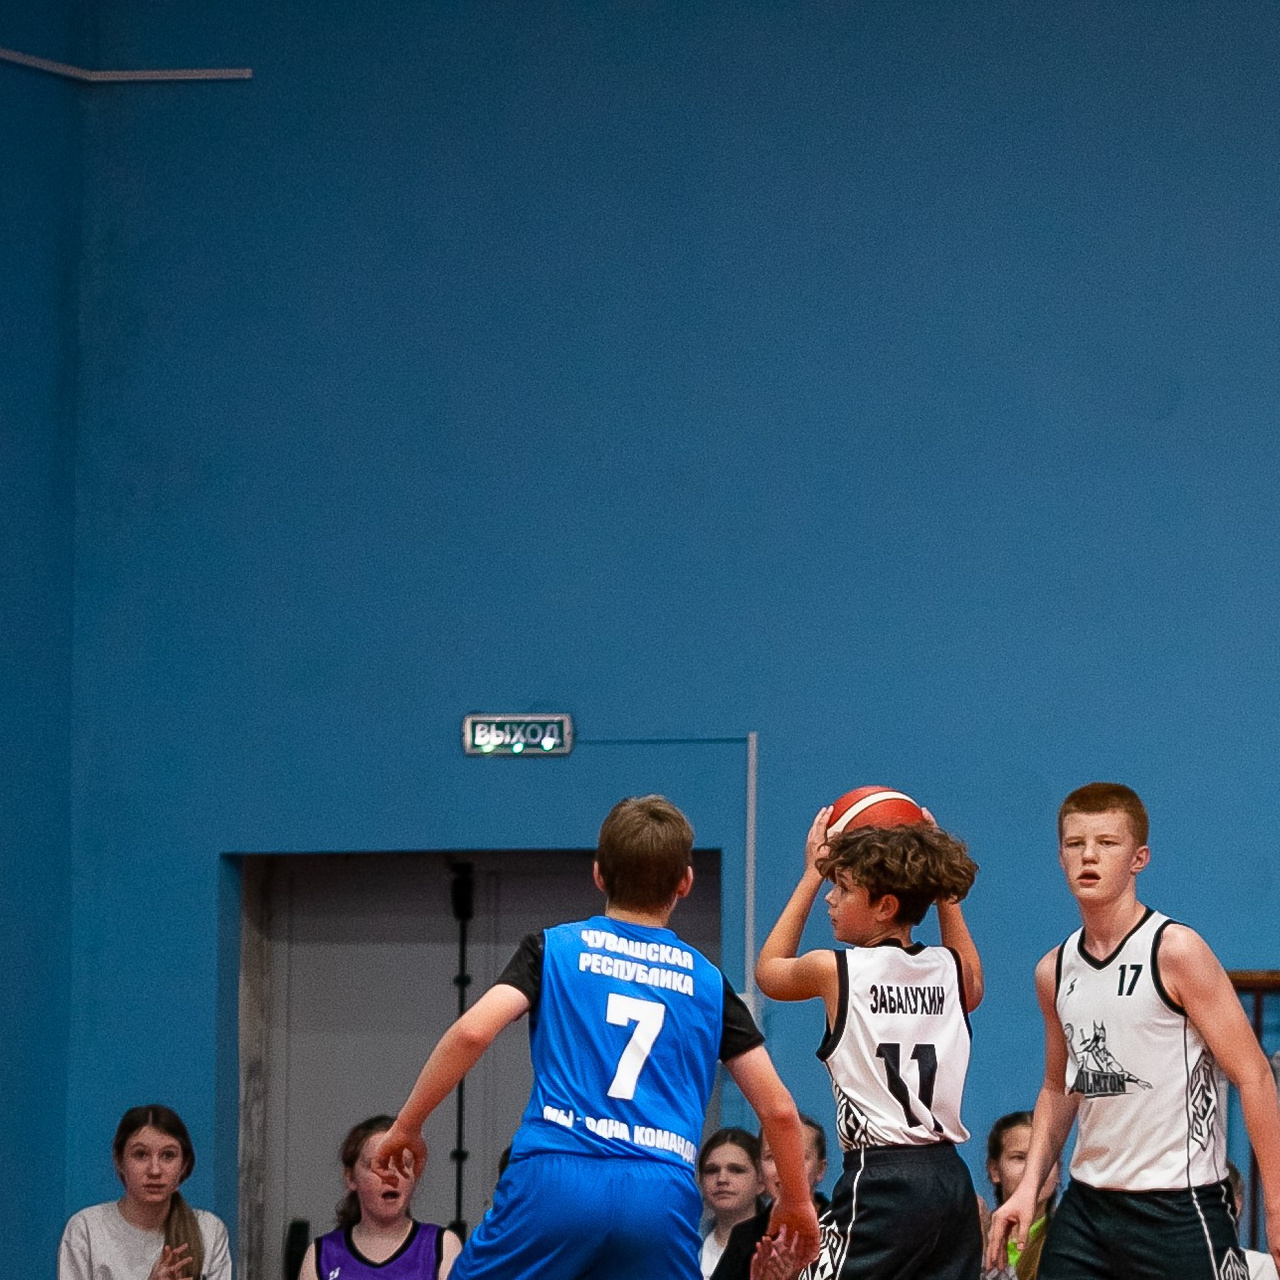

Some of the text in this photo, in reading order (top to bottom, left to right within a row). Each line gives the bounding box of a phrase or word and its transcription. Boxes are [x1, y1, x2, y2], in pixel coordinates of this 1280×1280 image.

[474, 723, 561, 747] ВЫХОД
[581, 929, 693, 970] ЧУВАШСКАЯ
[579, 952, 694, 996] РЕСПУБЛИКА
[1117, 964, 1143, 996] 17
[870, 984, 945, 1015] ЗАБАЛУХИН
[606, 993, 666, 1100] 7
[876, 1043, 944, 1133] 11
